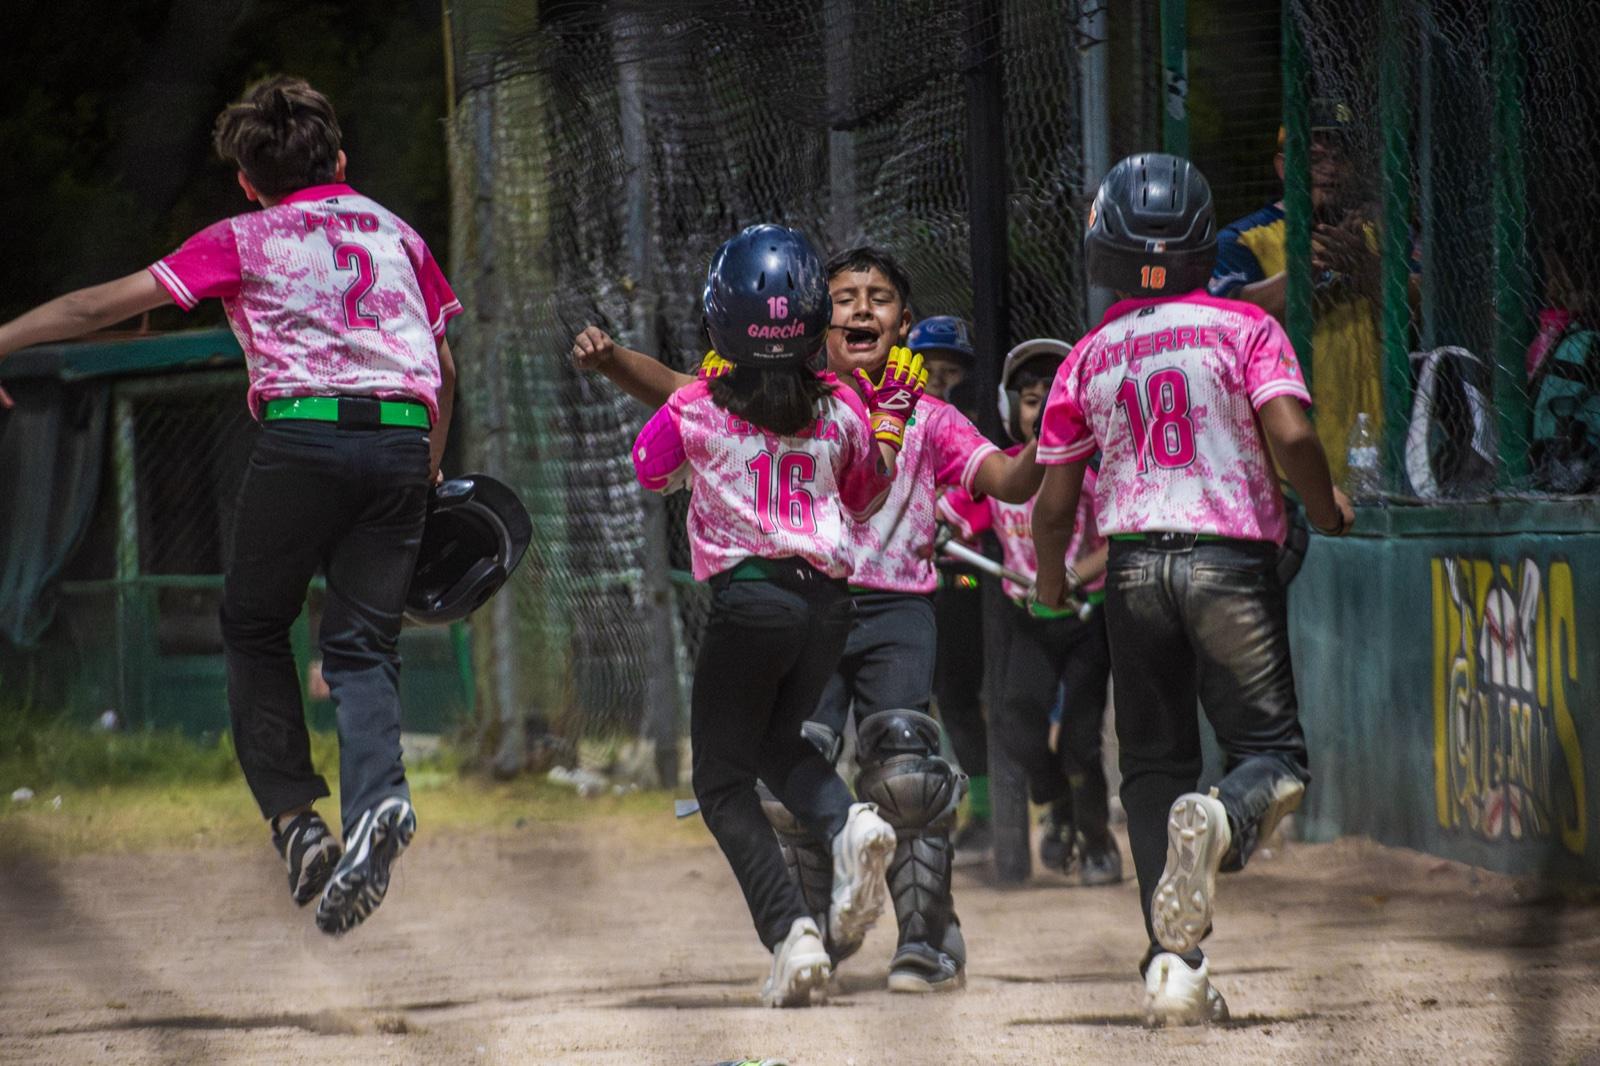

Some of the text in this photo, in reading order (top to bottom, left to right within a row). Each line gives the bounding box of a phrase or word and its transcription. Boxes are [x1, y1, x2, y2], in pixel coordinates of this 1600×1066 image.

[302, 210, 380, 233] PATO
[333, 242, 380, 331] 2
[767, 296, 789, 320] 16
[747, 318, 806, 340] GARCÍA
[1114, 367, 1197, 476] 18
[745, 450, 818, 536] 16
